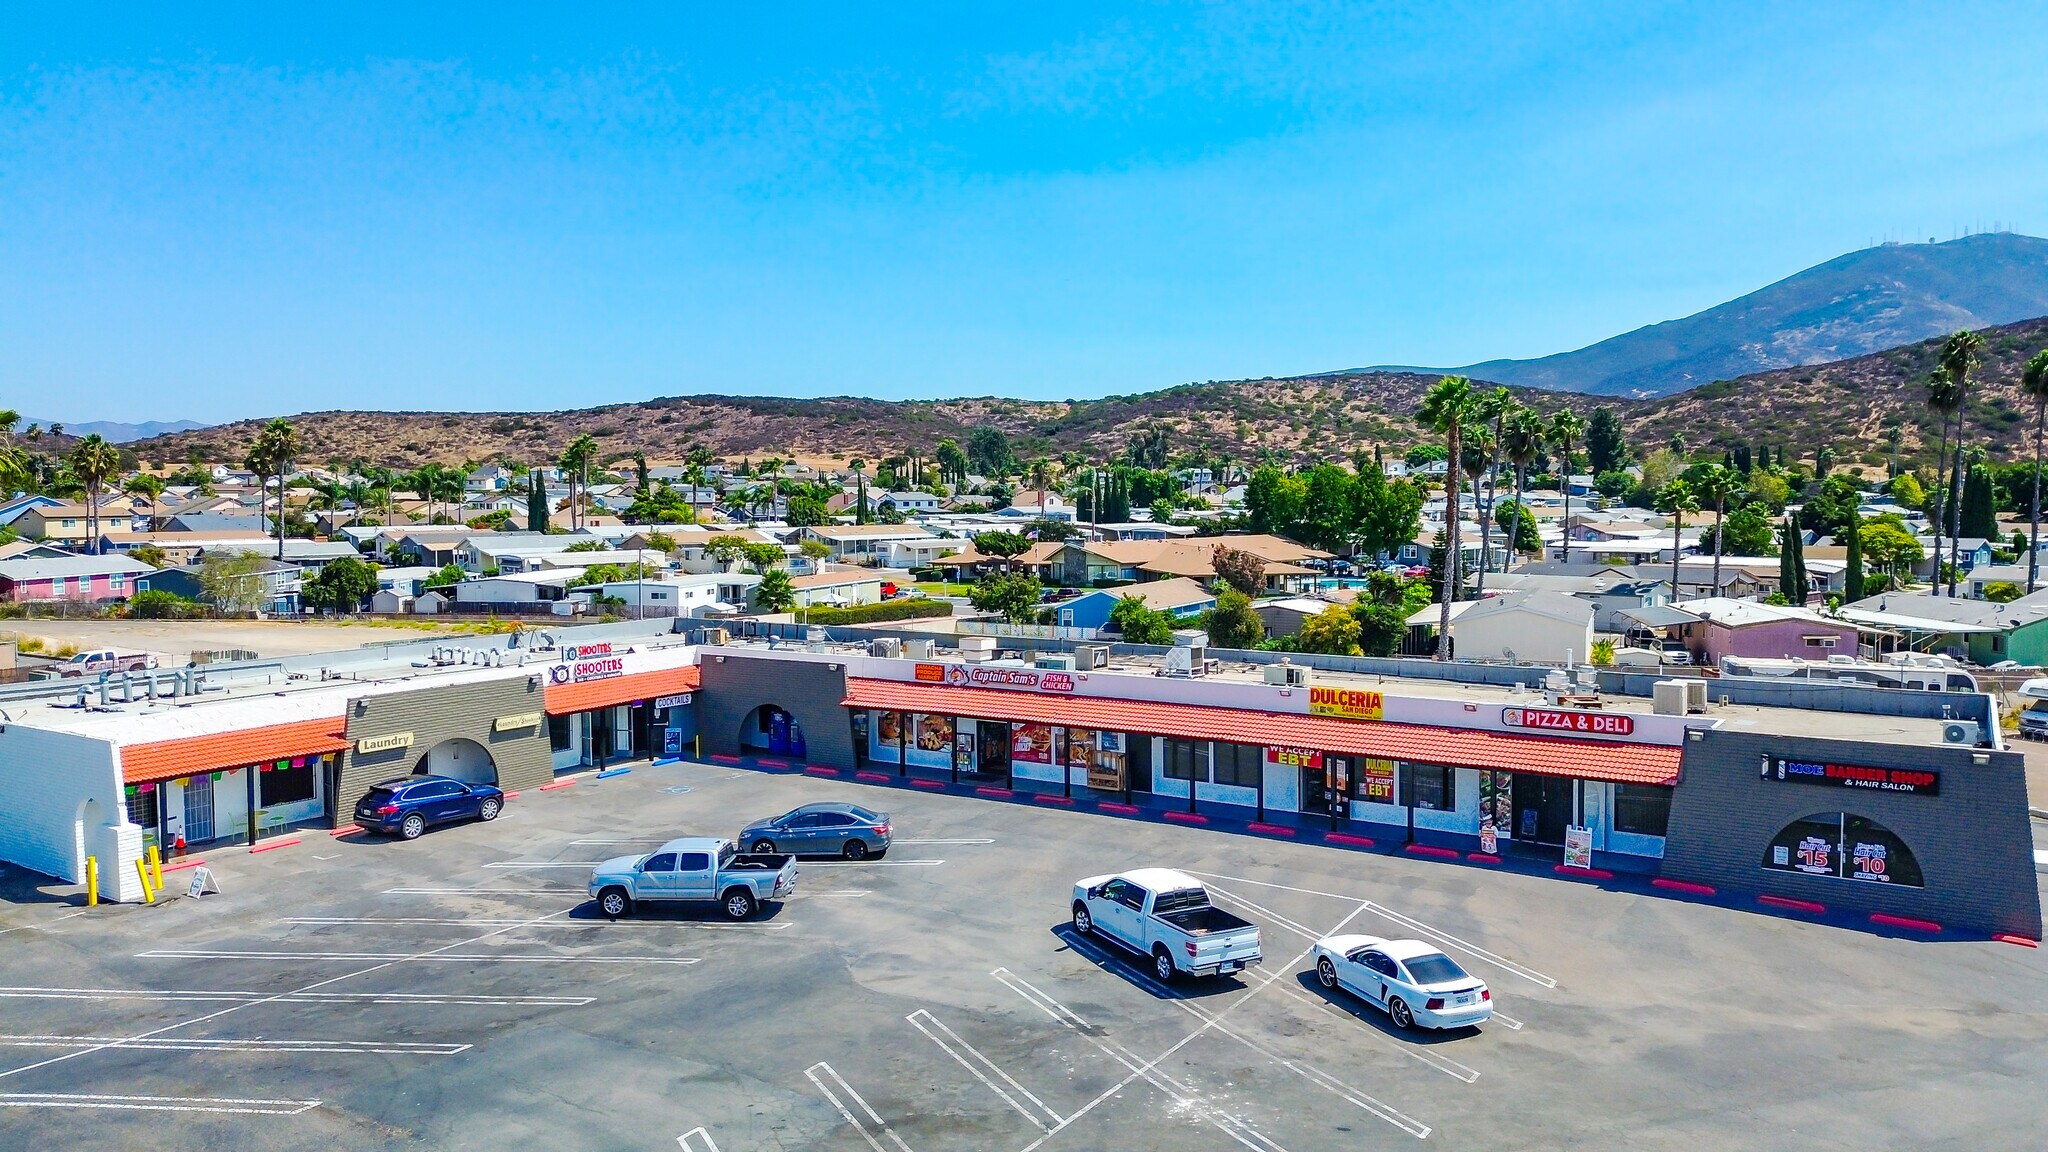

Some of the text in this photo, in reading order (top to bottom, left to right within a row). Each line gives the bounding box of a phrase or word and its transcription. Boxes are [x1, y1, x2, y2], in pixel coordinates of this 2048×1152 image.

[578, 643, 612, 656] SHOOTERS
[576, 658, 623, 675] SHOOTERS
[971, 669, 1037, 685] Captain Sam's
[1045, 674, 1062, 682] FISH
[1041, 681, 1073, 690] CHICKEN
[658, 695, 690, 707] COCKTAILS
[1310, 687, 1382, 709] DULCERIA
[1341, 706, 1374, 715] SAN DIEGO
[1526, 711, 1628, 733] PIZZA & DELI
[364, 734, 409, 750] Laundry
[1269, 745, 1322, 757] WE ACCEPT
[1278, 752, 1312, 767] EBT
[1789, 763, 1935, 786] MOE BARBER SHOP
[1375, 778, 1394, 786] ACCEPT
[1855, 780, 1879, 788] HAIR
[1881, 782, 1915, 792] SALON
[1369, 784, 1390, 797] EBT
[1799, 841, 1831, 852] Hair Cut
[1854, 847, 1886, 858] Hair Cut
[1797, 850, 1828, 867] $15
[1853, 857, 1885, 874] $10
